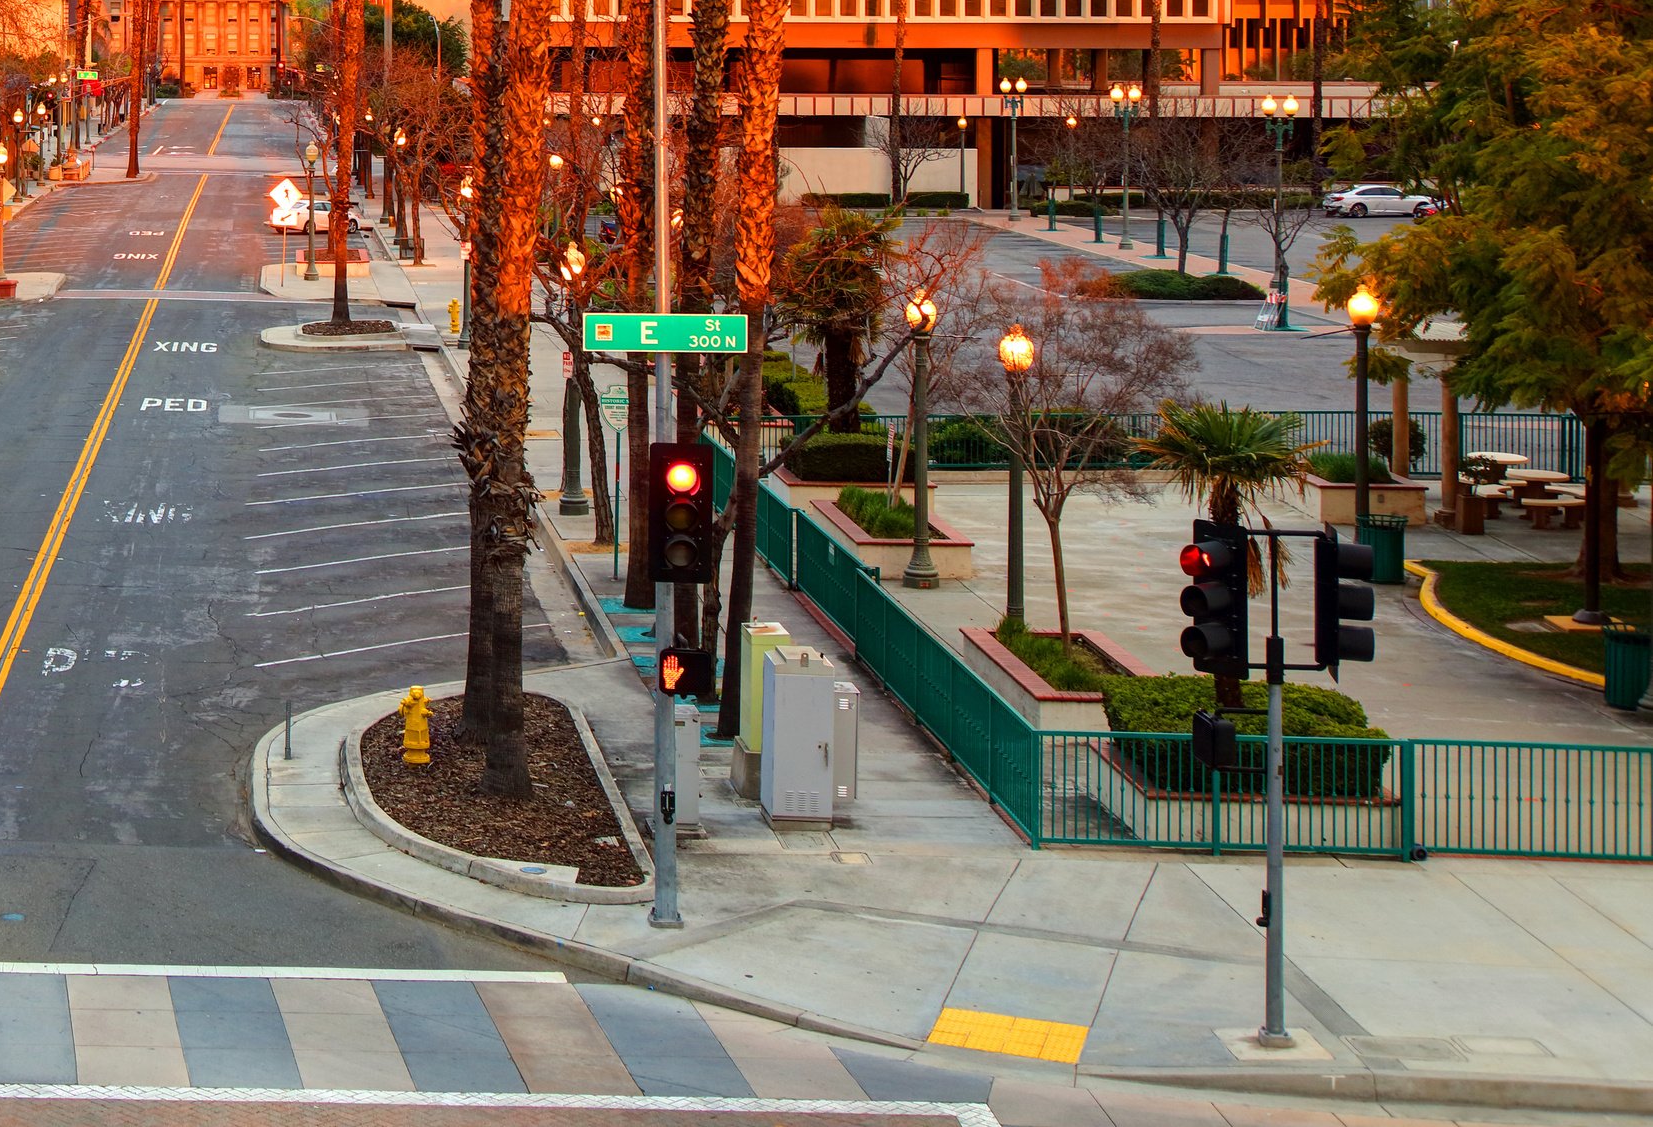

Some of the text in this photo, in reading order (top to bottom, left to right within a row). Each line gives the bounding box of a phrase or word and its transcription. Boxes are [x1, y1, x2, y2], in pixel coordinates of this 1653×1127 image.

[704, 319, 721, 332] St
[640, 321, 659, 345] E
[153, 341, 218, 353] XING
[688, 335, 736, 348] 300 N
[139, 397, 208, 412] PED
